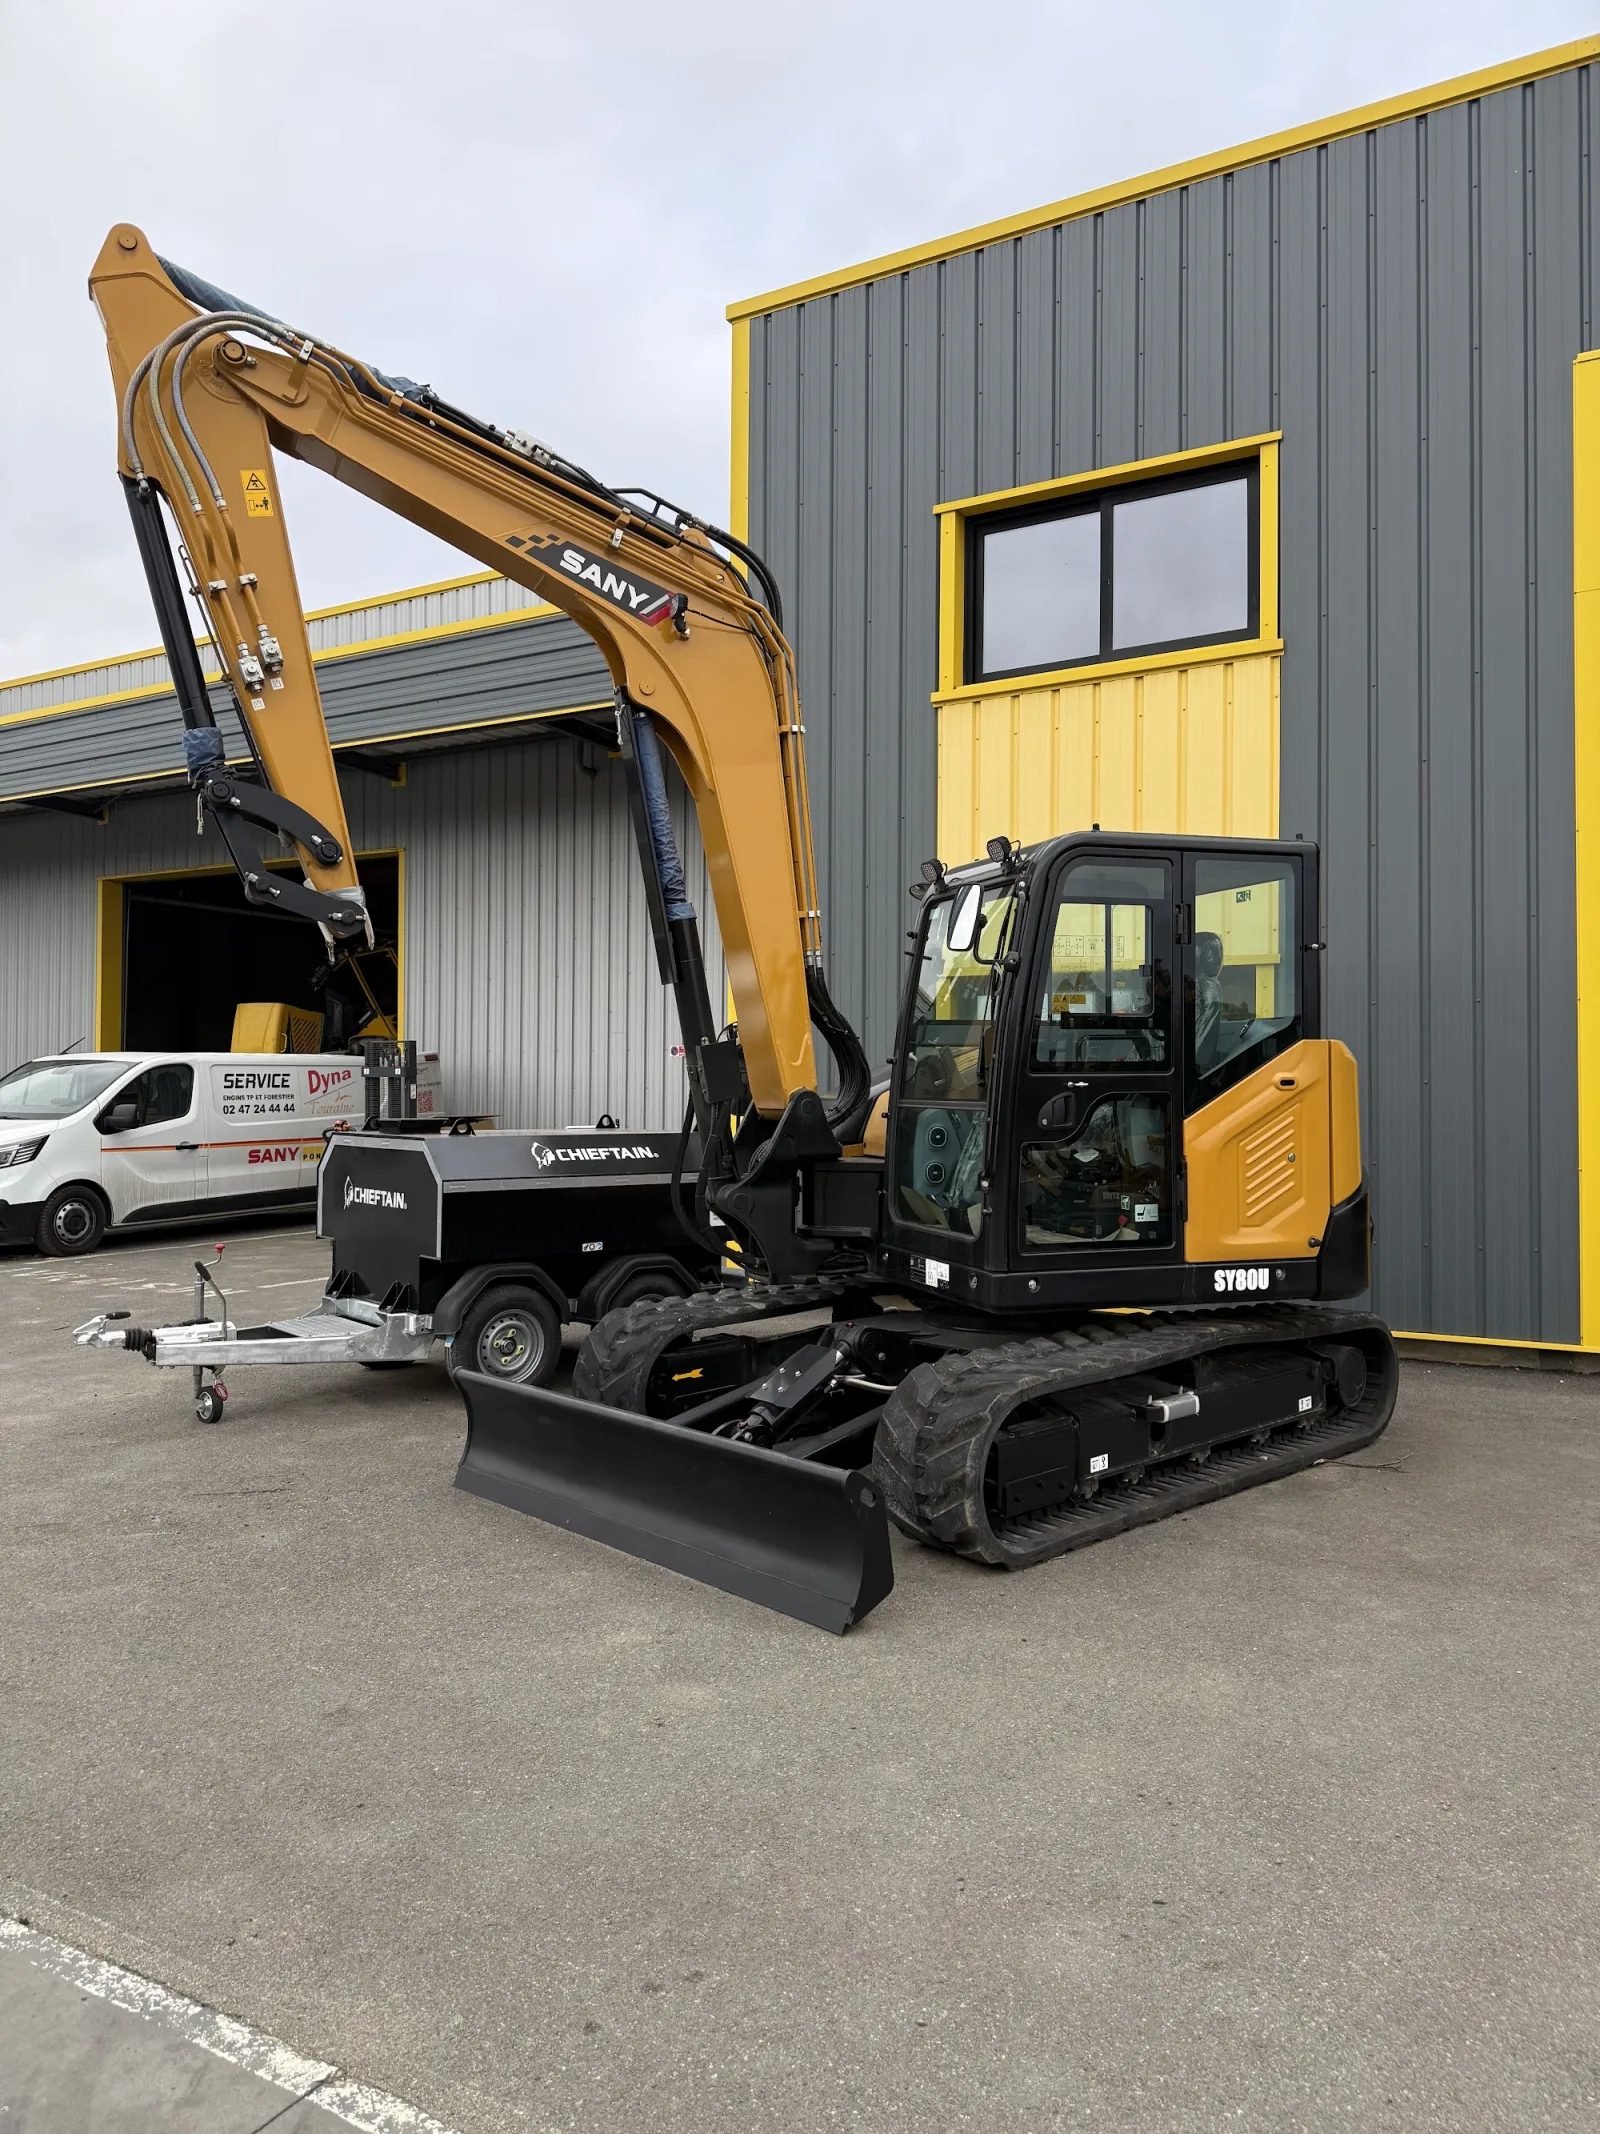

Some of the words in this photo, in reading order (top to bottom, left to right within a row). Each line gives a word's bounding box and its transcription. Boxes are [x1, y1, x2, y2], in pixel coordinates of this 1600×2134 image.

[559, 549, 650, 609] SANY
[223, 1073, 291, 1089] SERVICE
[307, 1069, 352, 1094] Dyna
[222, 1104, 236, 1115] 02
[238, 1104, 251, 1114] 47
[253, 1104, 266, 1114] 24
[268, 1103, 281, 1113] 44
[283, 1103, 296, 1113] 44
[309, 1101, 354, 1115] Touraine
[248, 1147, 300, 1164] SANY
[1213, 1267, 1270, 1292] SY80U
